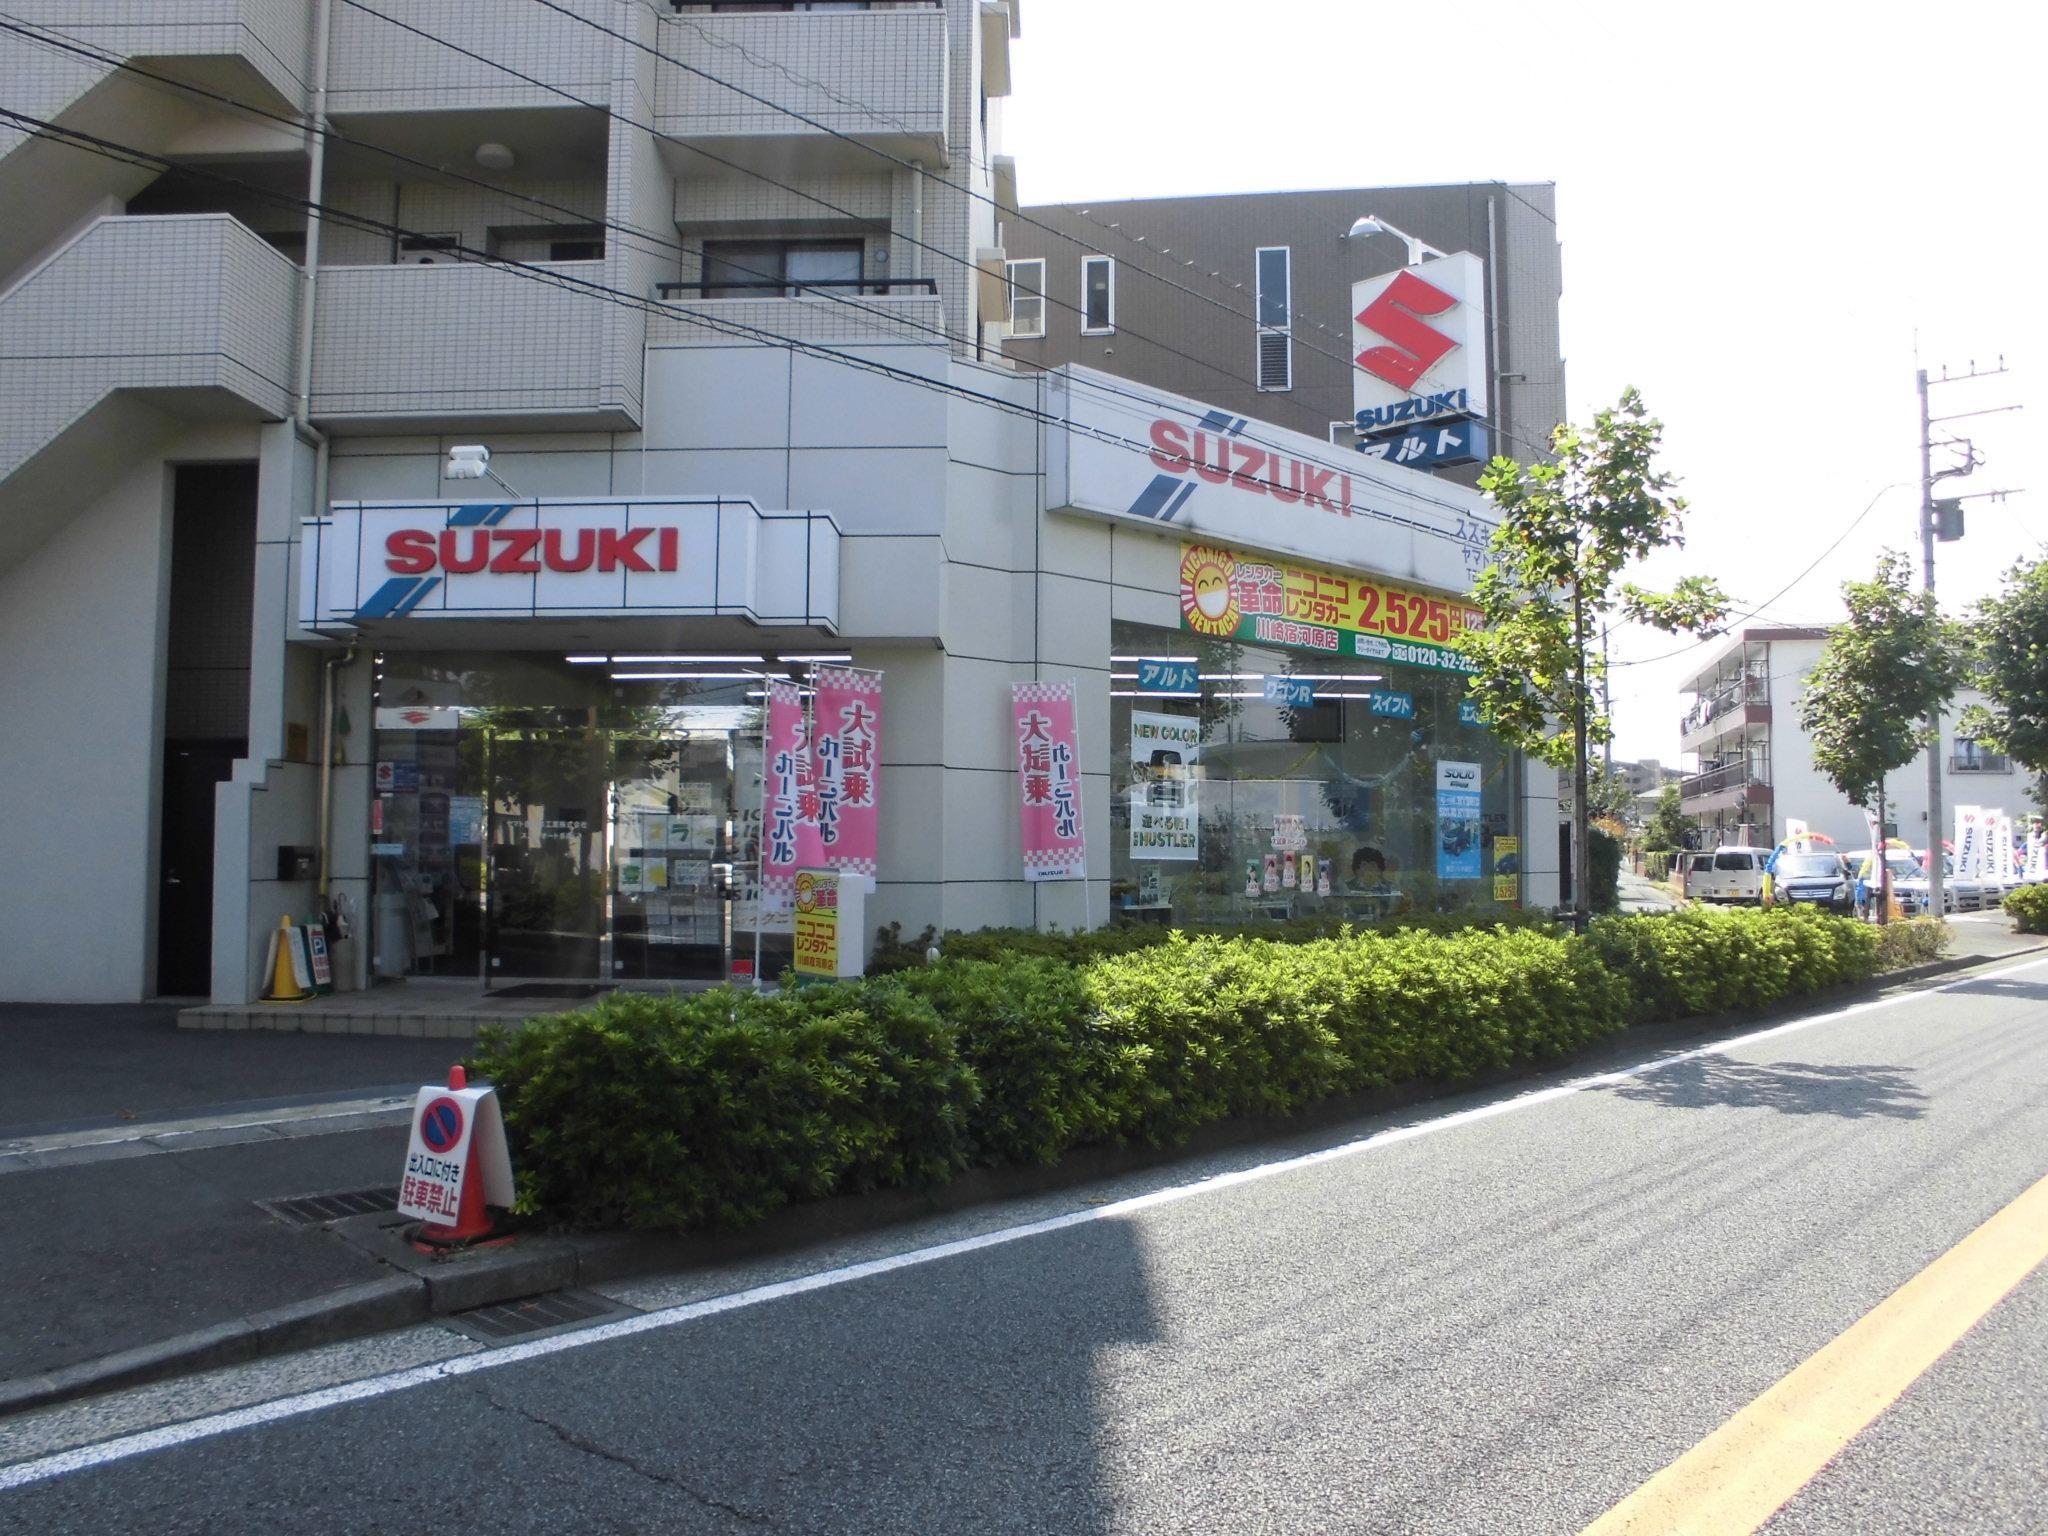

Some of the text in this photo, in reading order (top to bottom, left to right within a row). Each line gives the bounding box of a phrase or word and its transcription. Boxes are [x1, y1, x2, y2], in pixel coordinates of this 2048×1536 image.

[1356, 388, 1467, 430] SUZUKI
[1149, 418, 1352, 518] SUZUKI
[385, 527, 678, 574] SUZUKI
[1182, 546, 1236, 584] NICONICO
[1236, 564, 1282, 581] レンタカー
[1286, 569, 1349, 605] ニコニコ
[1238, 581, 1284, 615] 革命
[1286, 595, 1351, 625] レンタカー
[1256, 617, 1339, 651] 川崎宿河原店
[1142, 663, 1194, 689] アルト
[1407, 645, 1482, 674] 0120-32-2
[1373, 694, 1411, 715] スイフト
[1134, 723, 1198, 743] NEW COLOR
[841, 704, 873, 804] 大試乗
[818, 737, 839, 843] カーニバル
[771, 752, 794, 863] カーニバル
[1142, 813, 1189, 831] べる!
[1141, 831, 1195, 849] HUSTLER
[1960, 827, 1973, 872] SUZUKI
[1986, 830, 1995, 874] SUZUKI
[796, 937, 836, 954] レンタカー
[797, 920, 835, 940] ニコニコ
[409, 1152, 460, 1183] 出入口に付き
[402, 1175, 458, 1218] 駐車禁止
